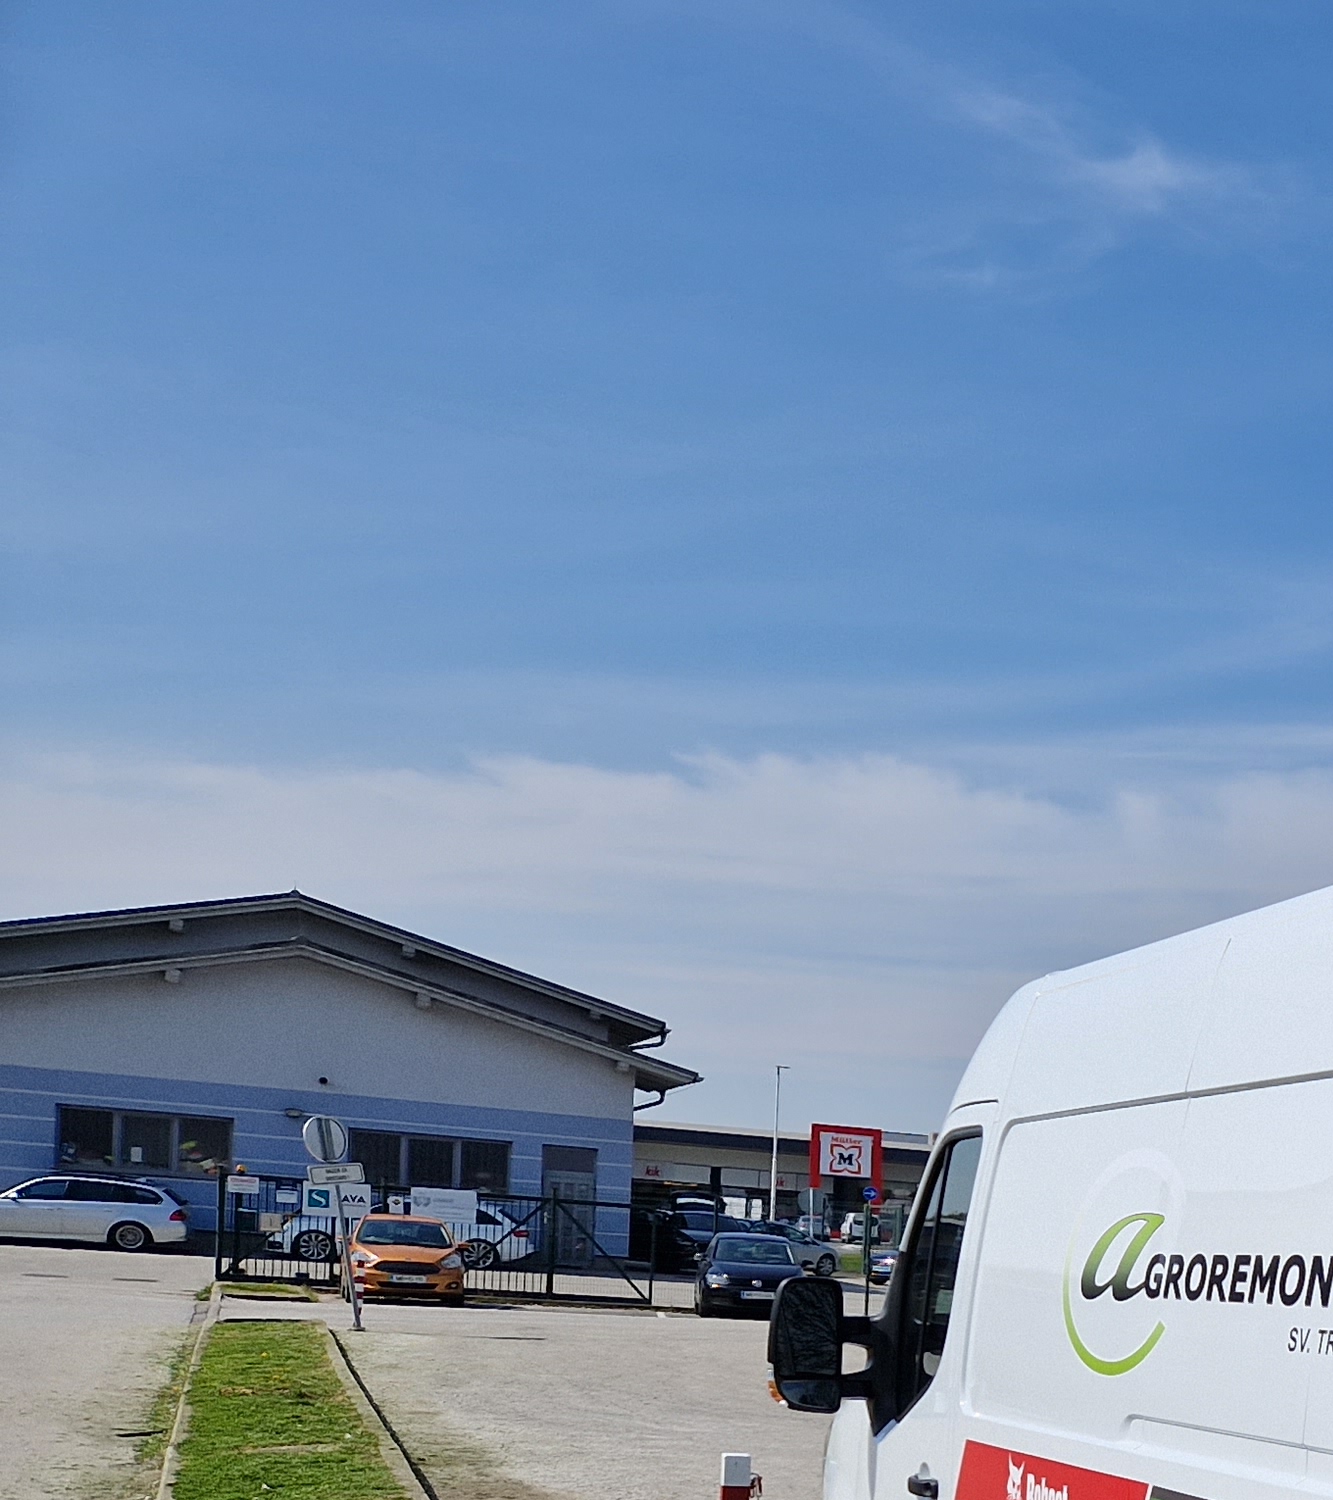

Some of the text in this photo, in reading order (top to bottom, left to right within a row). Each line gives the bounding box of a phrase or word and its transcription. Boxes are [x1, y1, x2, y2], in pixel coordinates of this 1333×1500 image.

[837, 1152, 854, 1166] M
[336, 1194, 366, 1204] AVA
[1287, 1327, 1311, 1354] SV.
